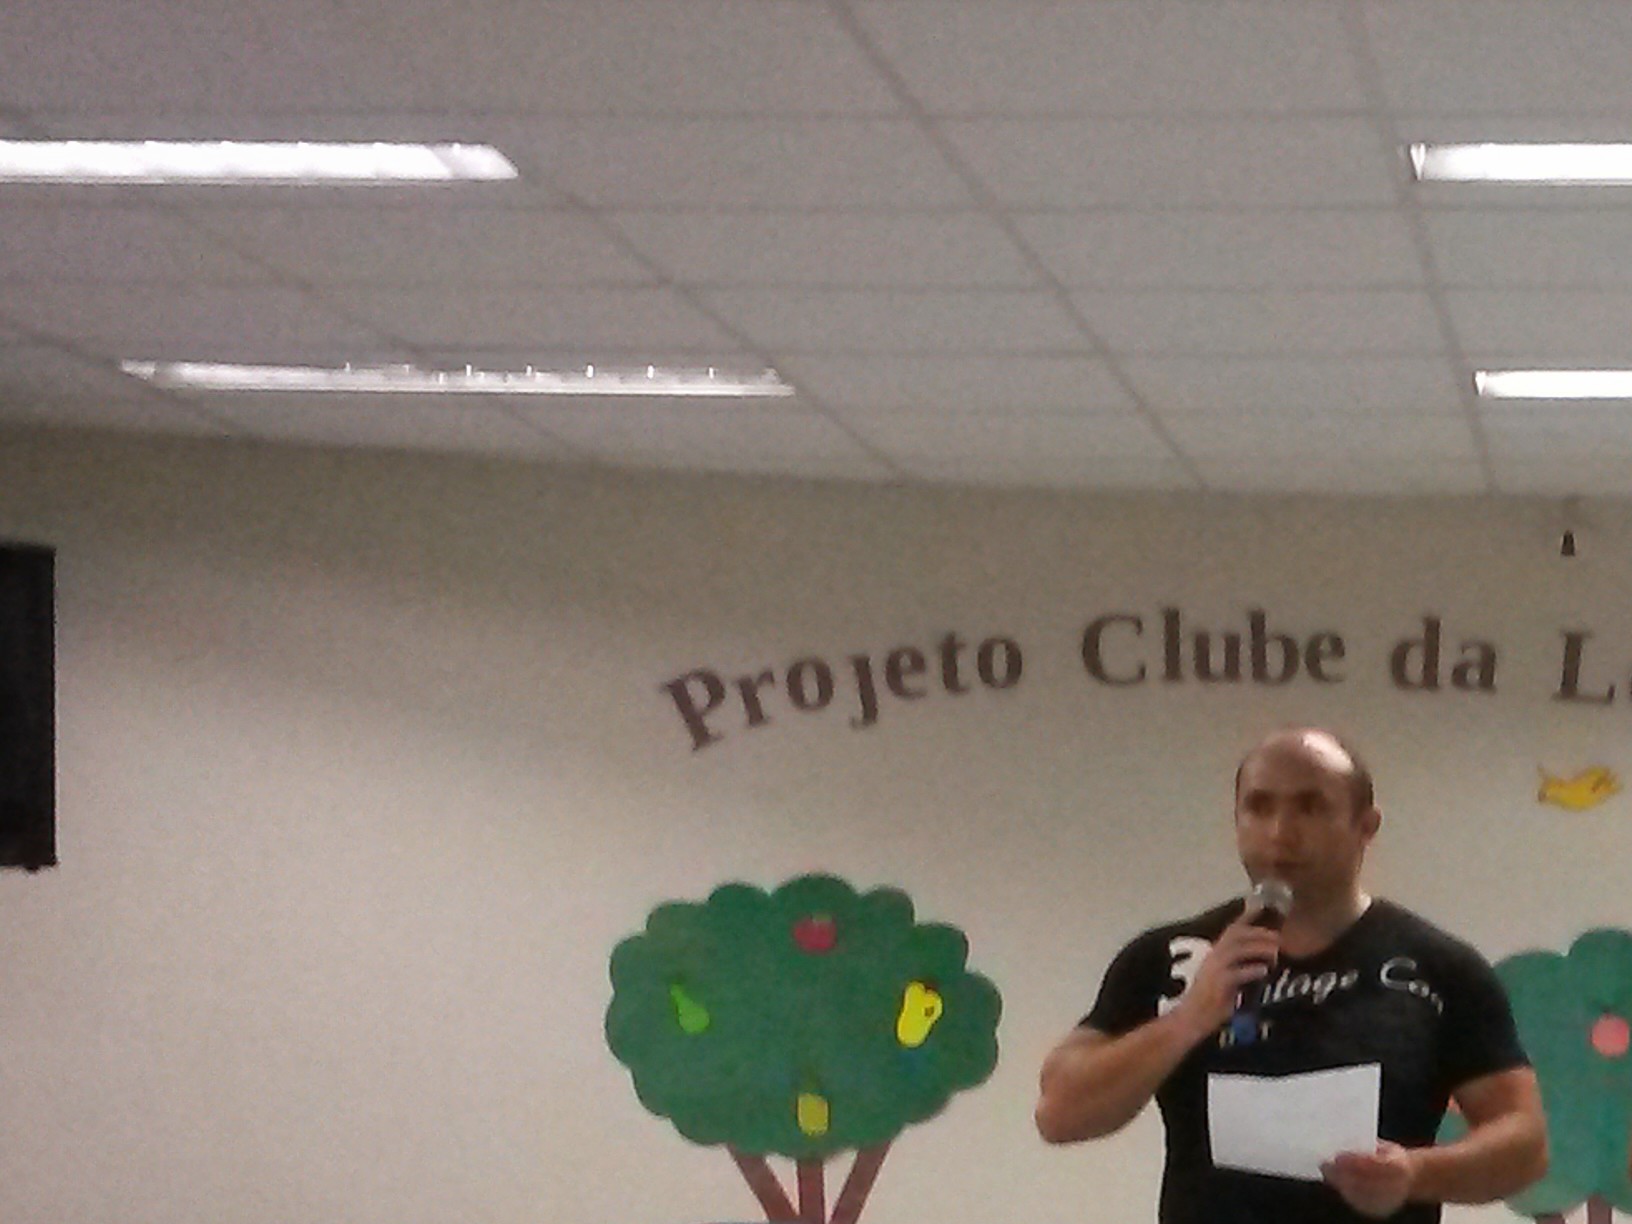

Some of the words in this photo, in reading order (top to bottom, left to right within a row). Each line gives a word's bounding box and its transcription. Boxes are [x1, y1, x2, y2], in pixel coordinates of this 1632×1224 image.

[660, 630, 1024, 752] Projeto
[1080, 606, 1348, 688] Clube
[1387, 614, 1498, 693] da
